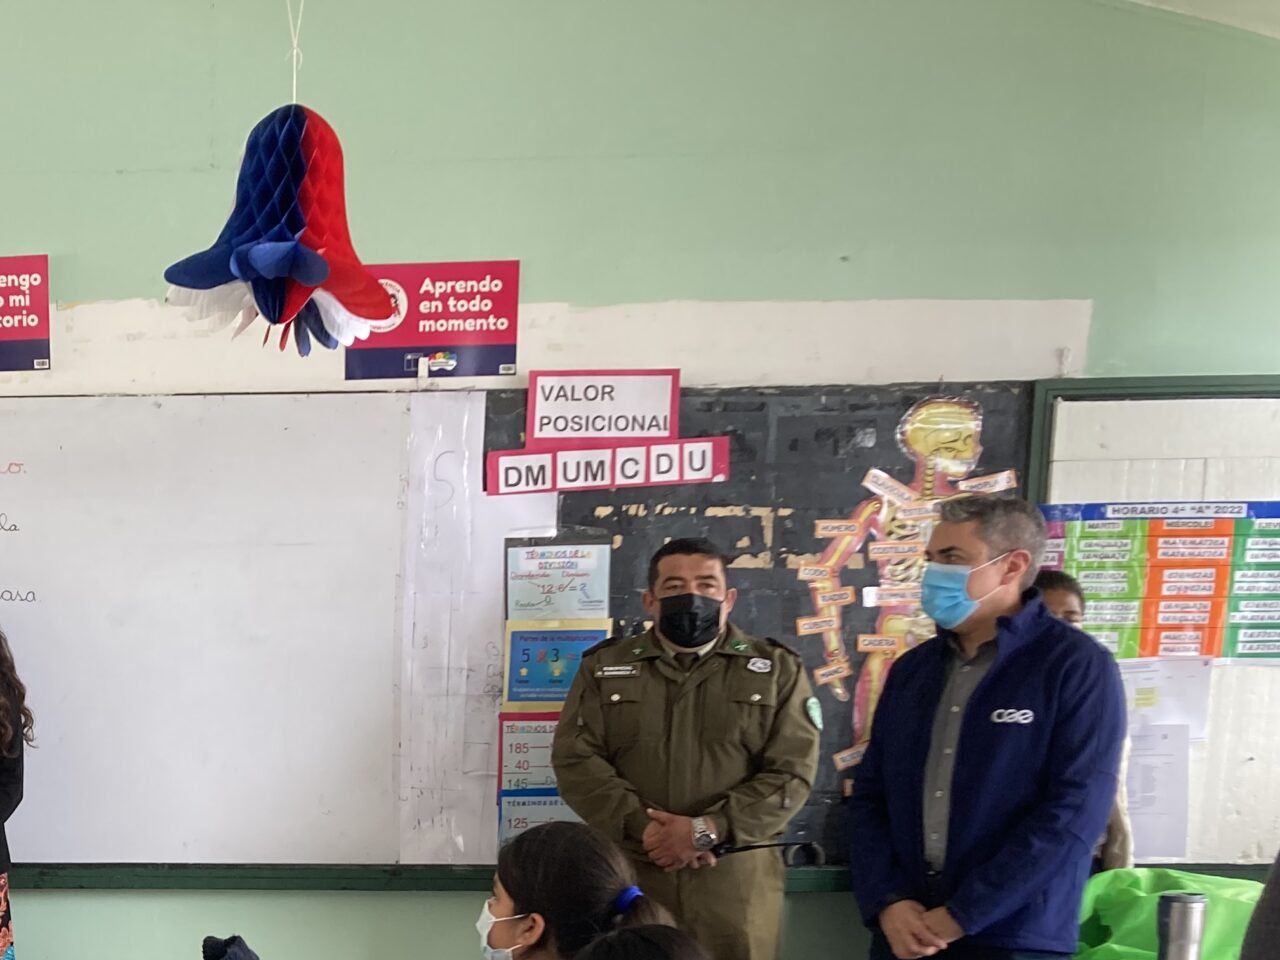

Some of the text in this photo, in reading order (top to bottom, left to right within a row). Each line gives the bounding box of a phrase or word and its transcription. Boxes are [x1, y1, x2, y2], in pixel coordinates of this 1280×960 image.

[419, 274, 503, 298] Aprendo
[9, 290, 30, 307] mi
[419, 294, 493, 313] en todo
[418, 315, 509, 332] momento
[540, 384, 615, 402] VALOR
[538, 414, 669, 432] POSICIONAL
[504, 449, 707, 488] DM UM C D U
[1111, 506, 1168, 515] HORARIO
[1213, 505, 1243, 514] 2022
[521, 648, 531, 663] 5
[551, 648, 560, 663] 3
[508, 743, 530, 754] 185
[514, 760, 530, 770] 40
[507, 778, 529, 789] 145
[507, 818, 529, 829] 125
